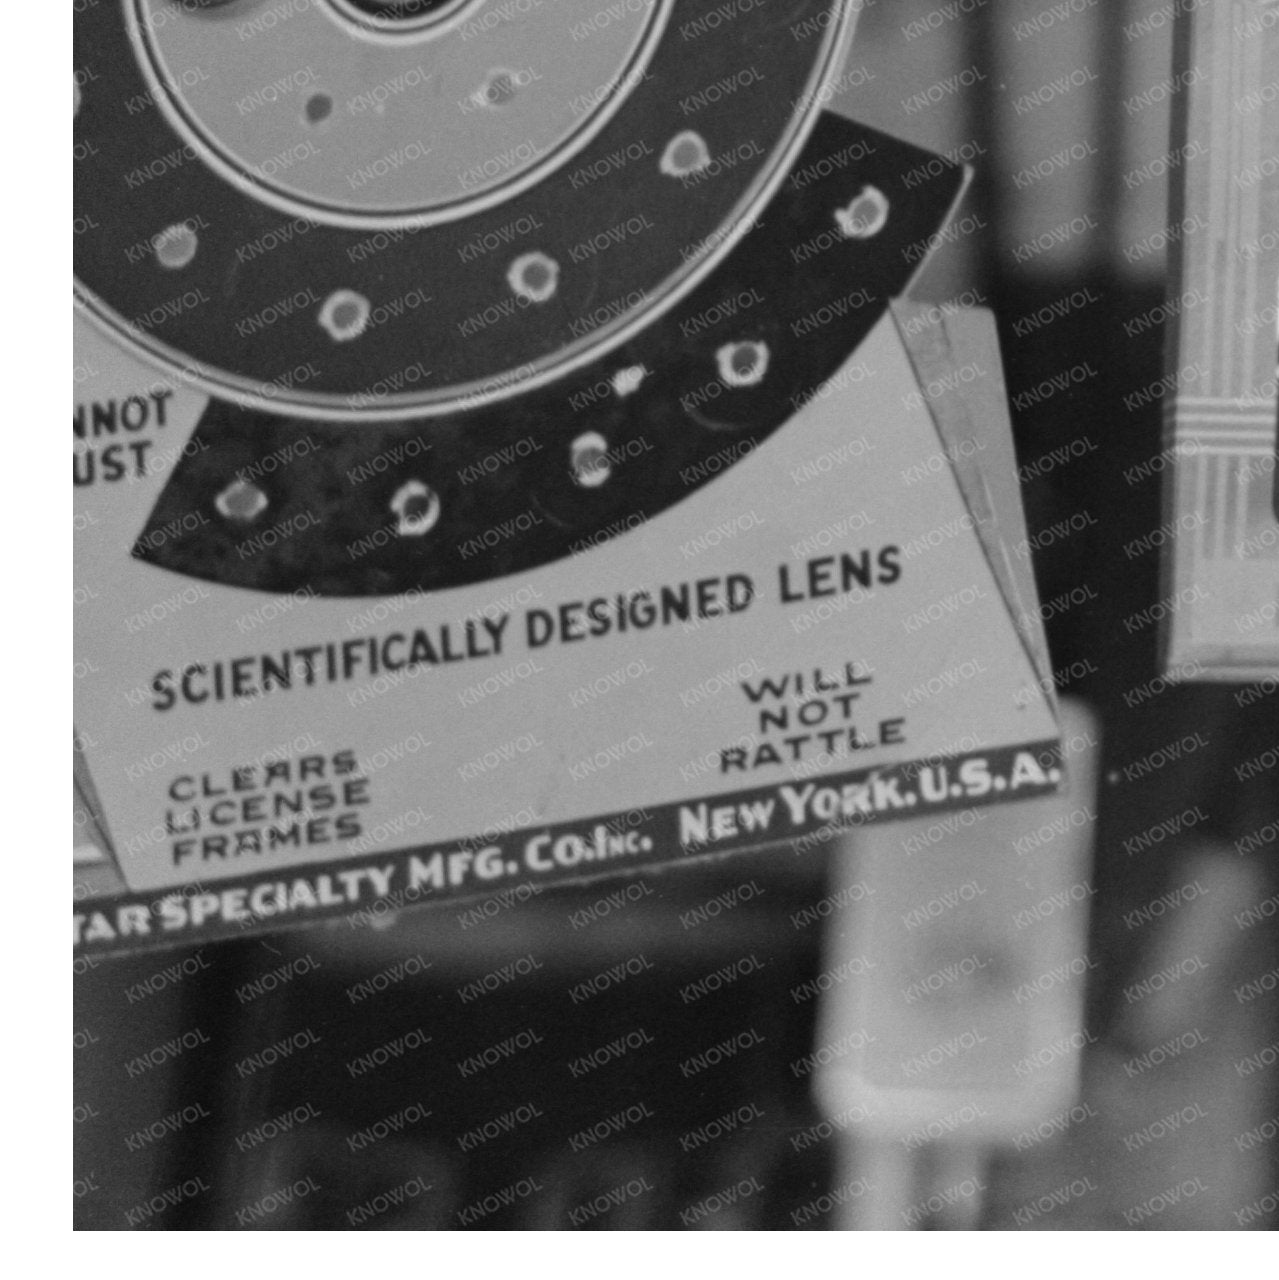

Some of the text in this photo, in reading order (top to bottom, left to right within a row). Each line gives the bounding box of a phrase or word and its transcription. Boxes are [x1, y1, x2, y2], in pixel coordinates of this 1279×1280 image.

[151, 545, 902, 711] SCIENTIFICALLY DESIGNED LENS
[741, 662, 873, 704] WILL
[757, 693, 860, 735] NOT
[719, 717, 907, 774] RATTLE
[168, 750, 357, 803] CLEARS
[166, 777, 371, 834] LICENSE
[172, 812, 362, 866] FRAMES
[161, 865, 395, 931] SPECIALTY
[408, 845, 518, 890] MFG.
